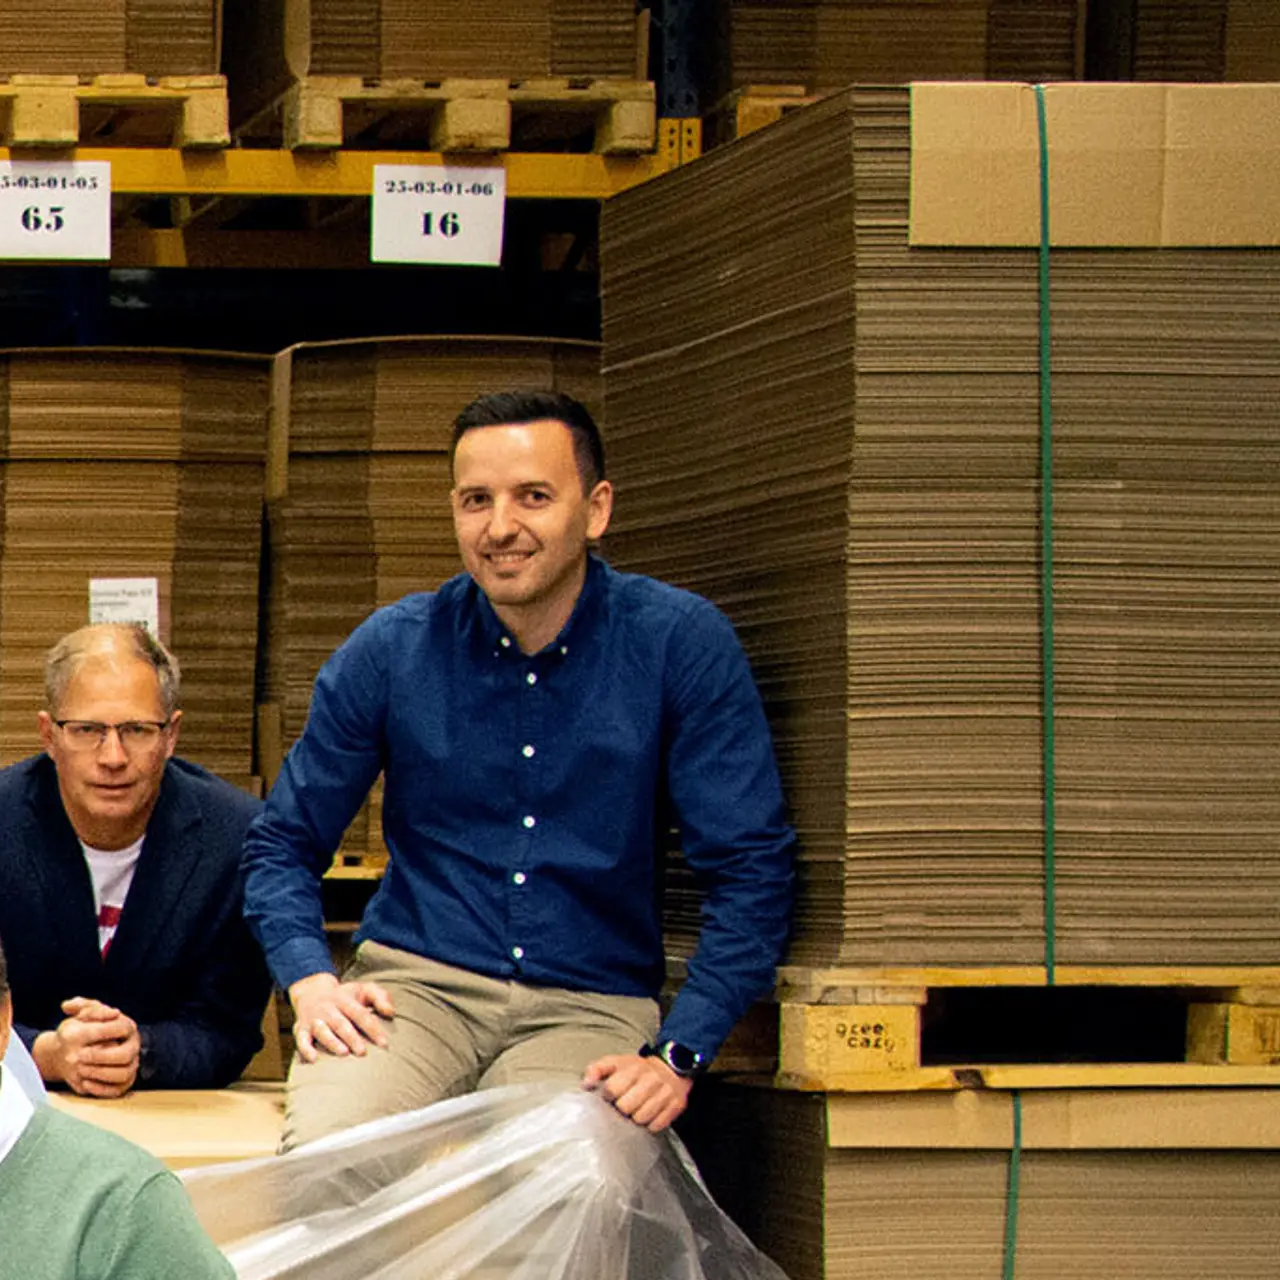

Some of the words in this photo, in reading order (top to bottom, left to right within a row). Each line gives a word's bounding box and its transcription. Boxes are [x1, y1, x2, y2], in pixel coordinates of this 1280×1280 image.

[385, 180, 493, 196] 25-03-01-06
[21, 206, 65, 232] 65
[421, 211, 460, 238] 16
